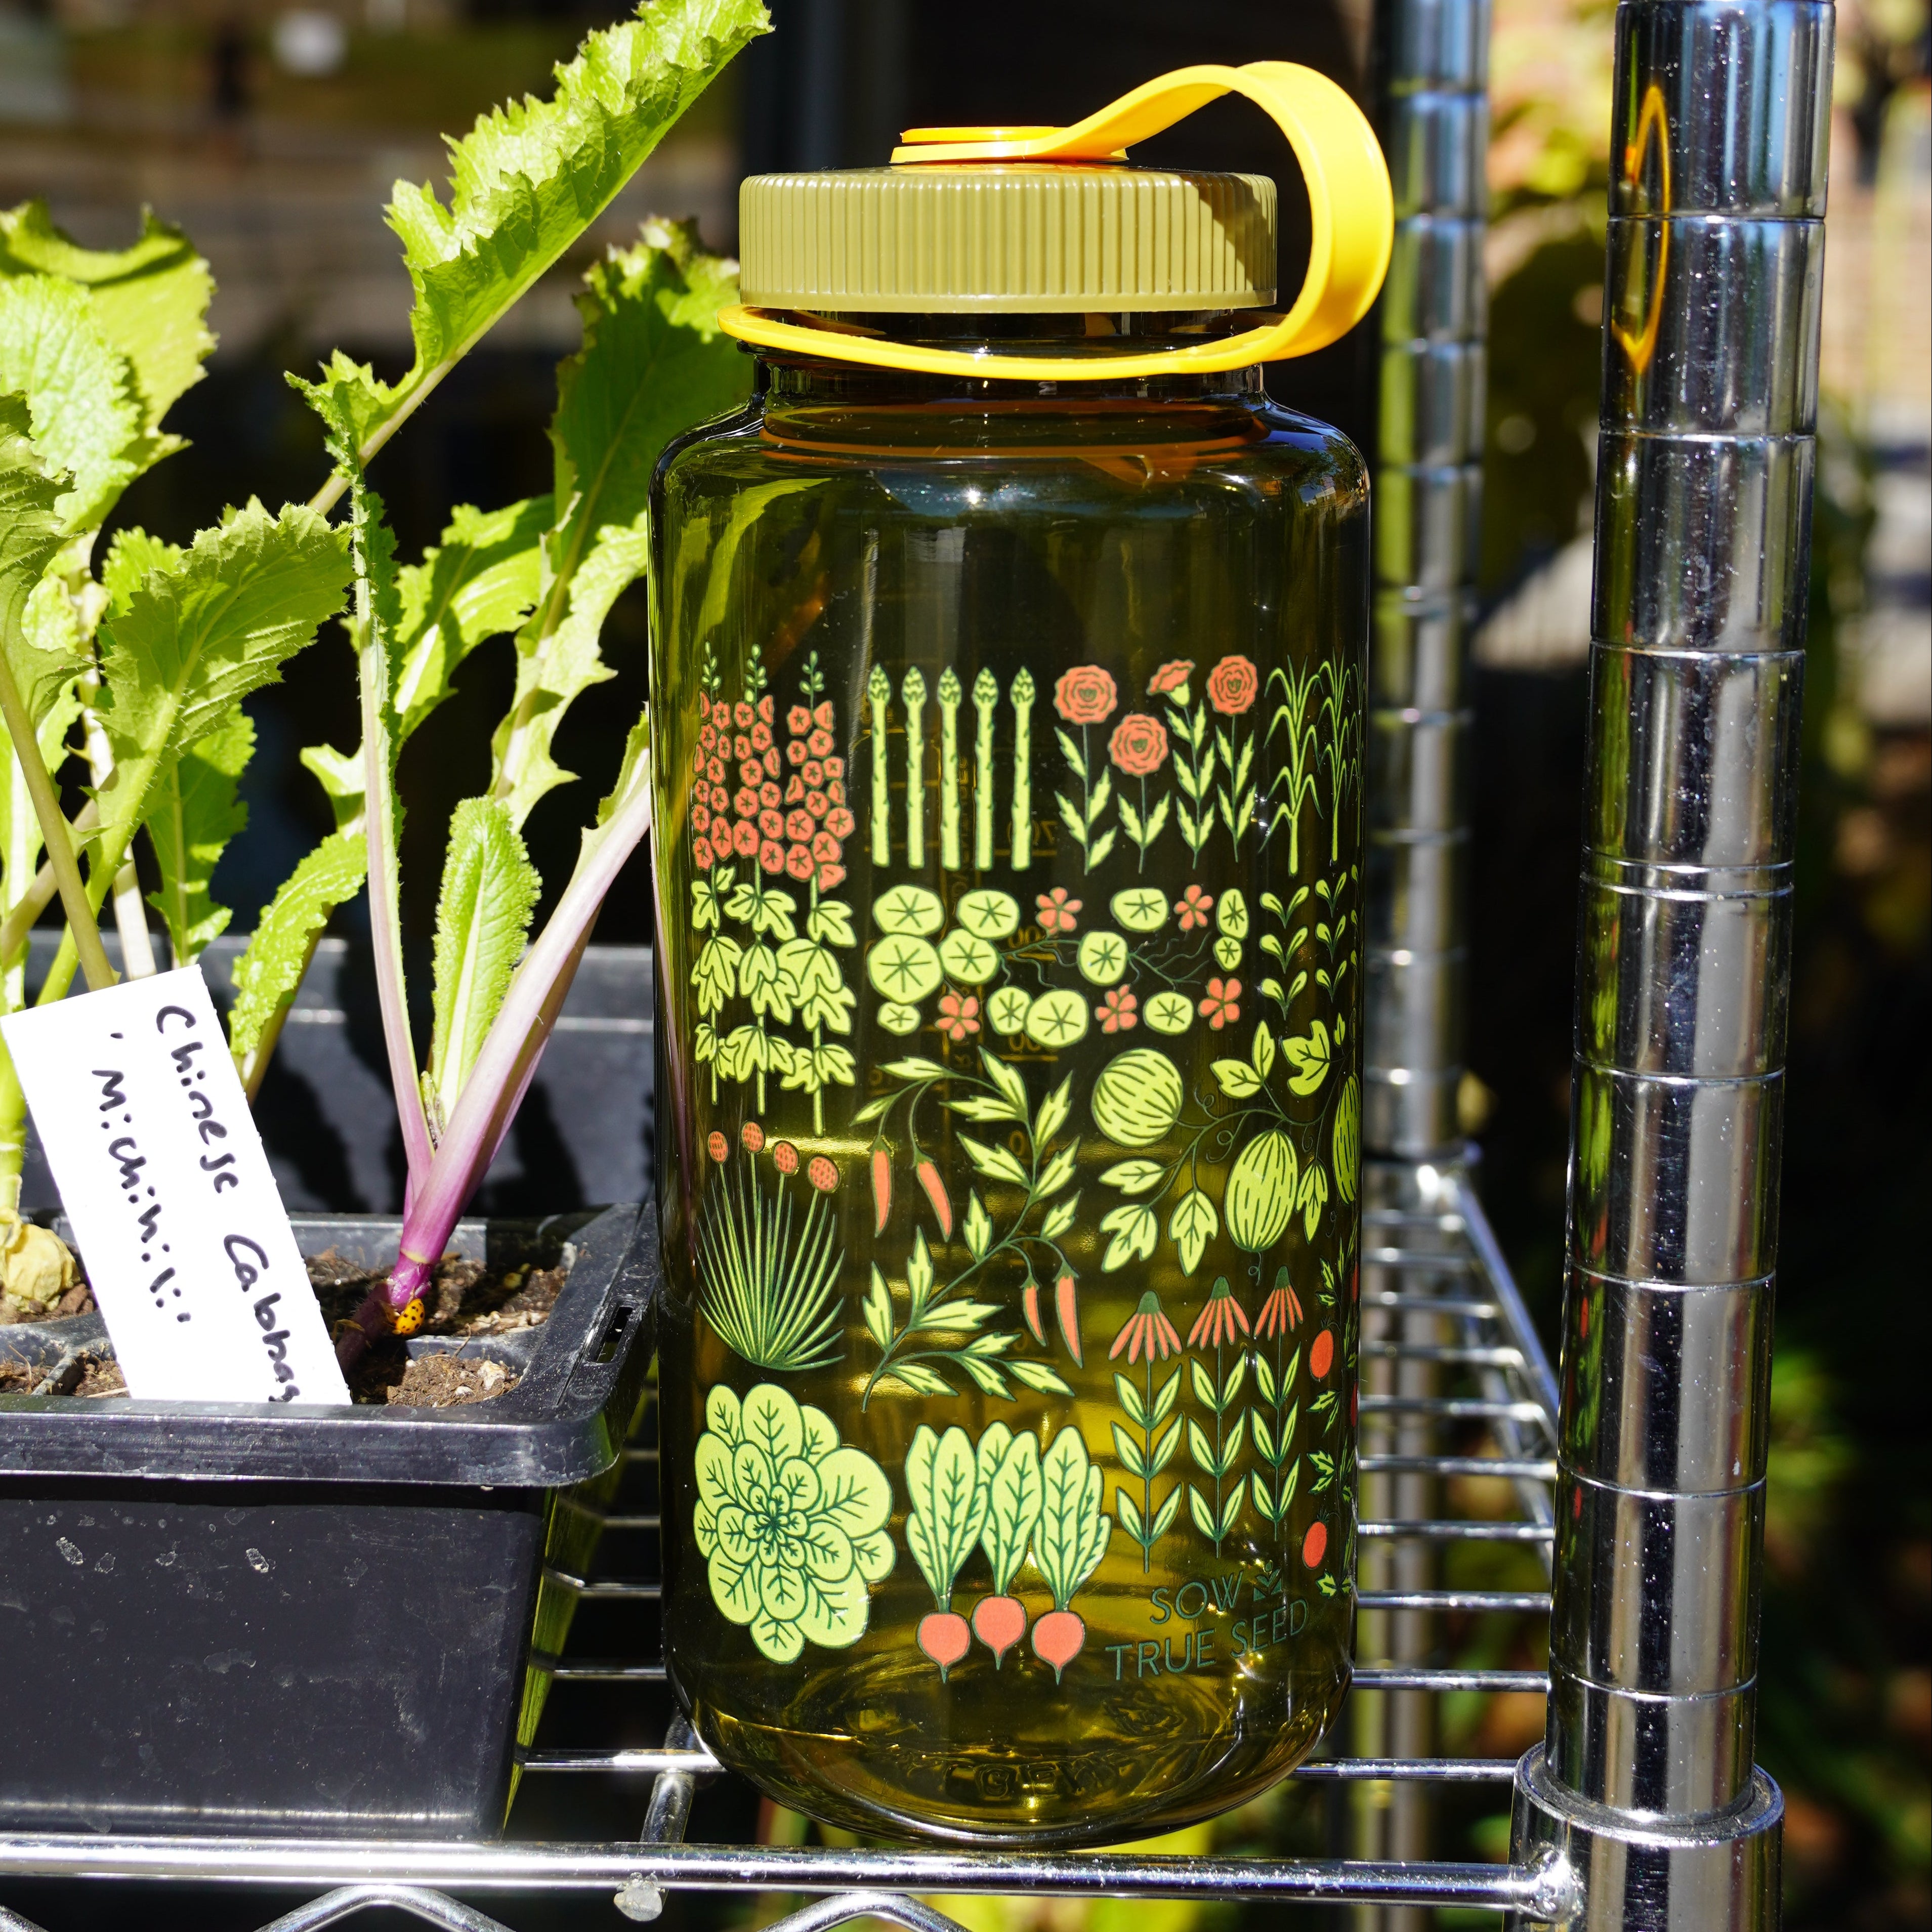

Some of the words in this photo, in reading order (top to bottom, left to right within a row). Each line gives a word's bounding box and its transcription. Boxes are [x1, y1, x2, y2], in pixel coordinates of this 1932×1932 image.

[156, 1005, 238, 1194] Chinese
[1150, 1571, 1244, 1624] SOW
[1105, 1629, 1215, 1681] TRUE
[1230, 1599, 1309, 1658] SEED
